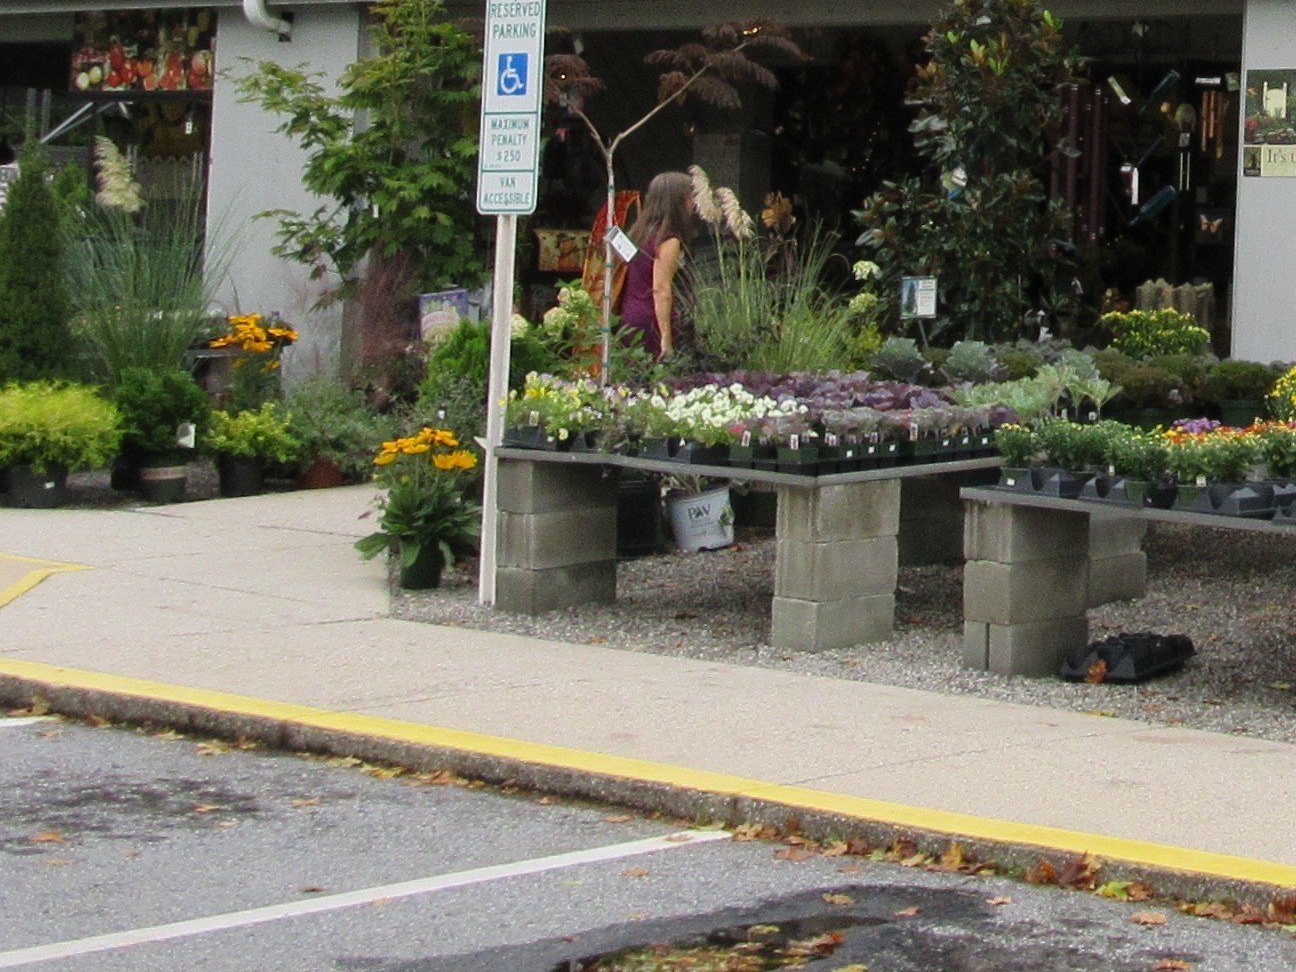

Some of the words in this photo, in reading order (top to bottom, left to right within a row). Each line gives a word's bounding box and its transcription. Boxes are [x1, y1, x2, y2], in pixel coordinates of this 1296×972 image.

[490, 1, 541, 18] RESERVED
[493, 23, 537, 38] PARKING
[490, 119, 530, 130] MAXIMUM
[491, 134, 527, 146] PENALTY
[1266, 149, 1287, 164] It's
[500, 177, 516, 187] VAN
[483, 192, 530, 205] ACCESSIBLE
